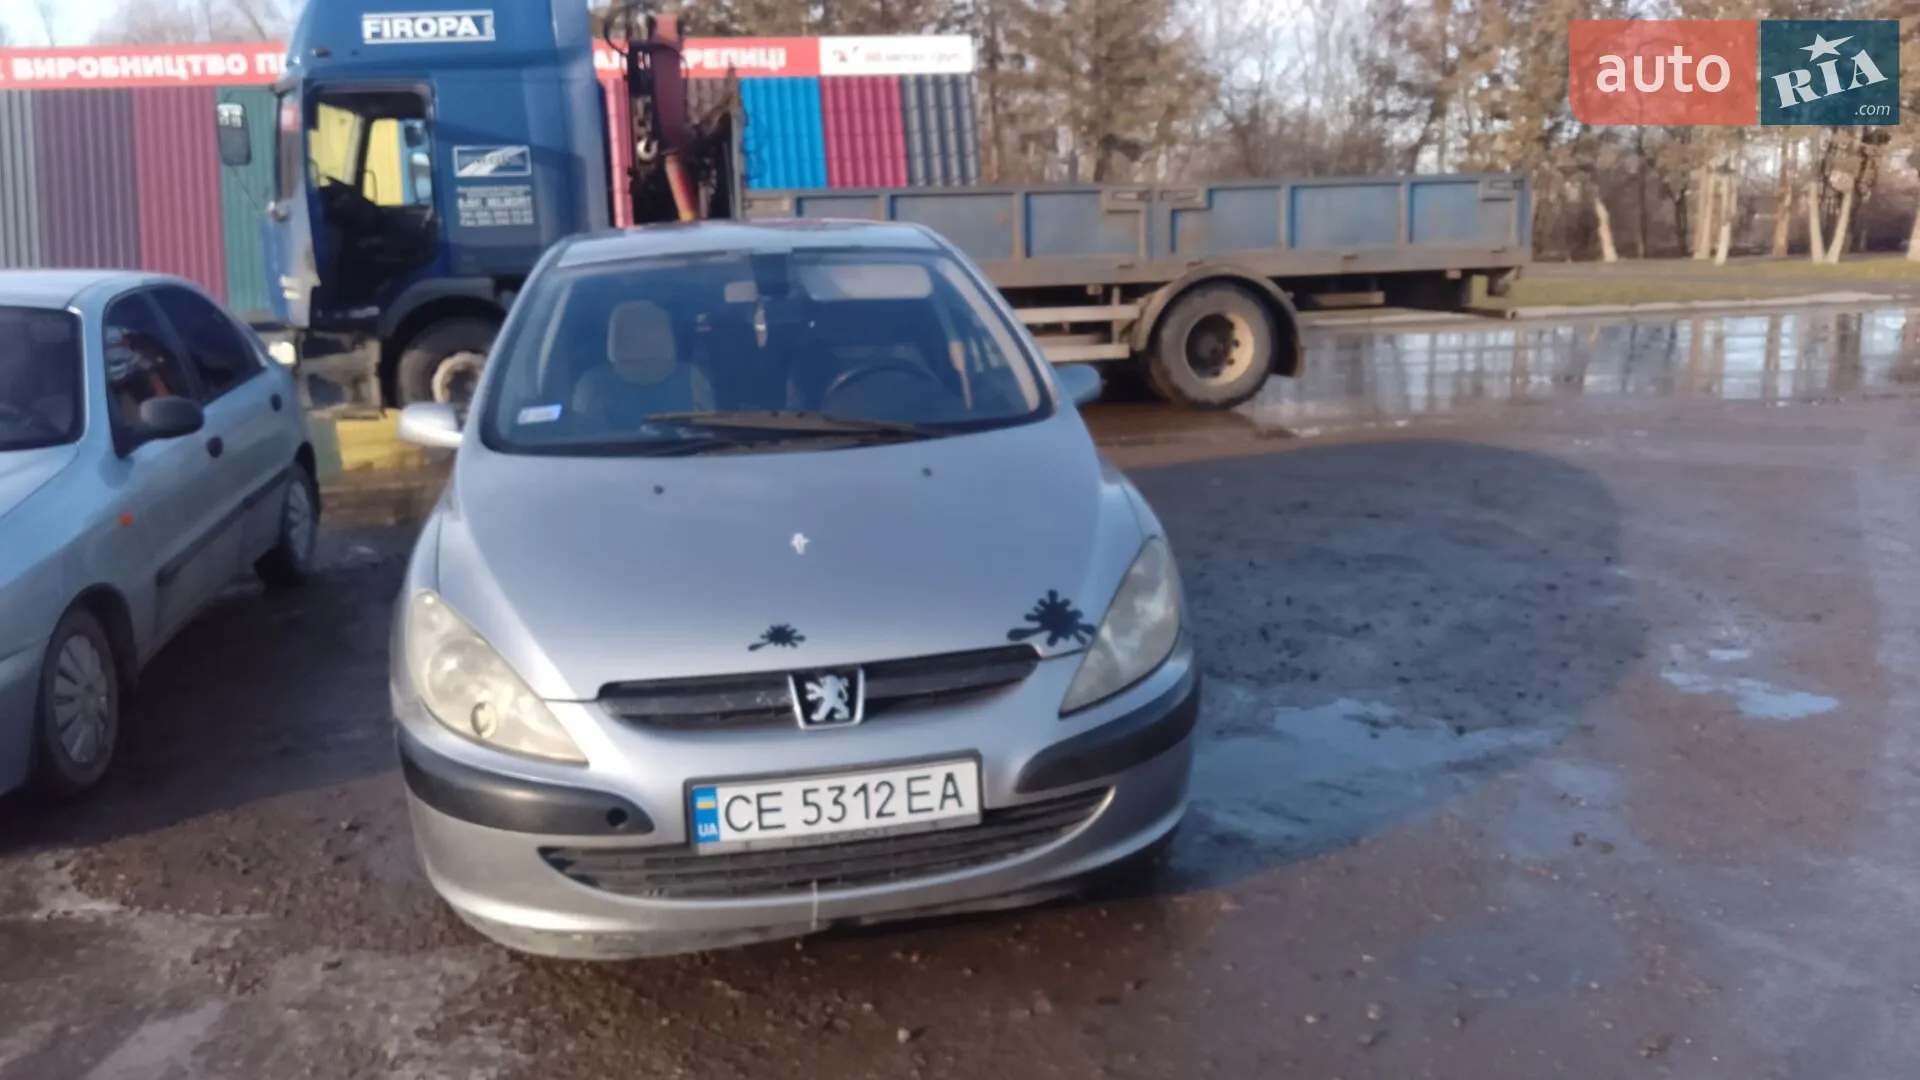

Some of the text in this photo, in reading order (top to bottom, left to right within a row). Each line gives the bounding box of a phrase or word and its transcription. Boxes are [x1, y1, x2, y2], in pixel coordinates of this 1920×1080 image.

[363, 15, 480, 40] FIROPA
[12, 54, 248, 80] ВИРОБНИЦТВО
[802, 779, 897, 826] 5312
[698, 823, 718, 837] UA
